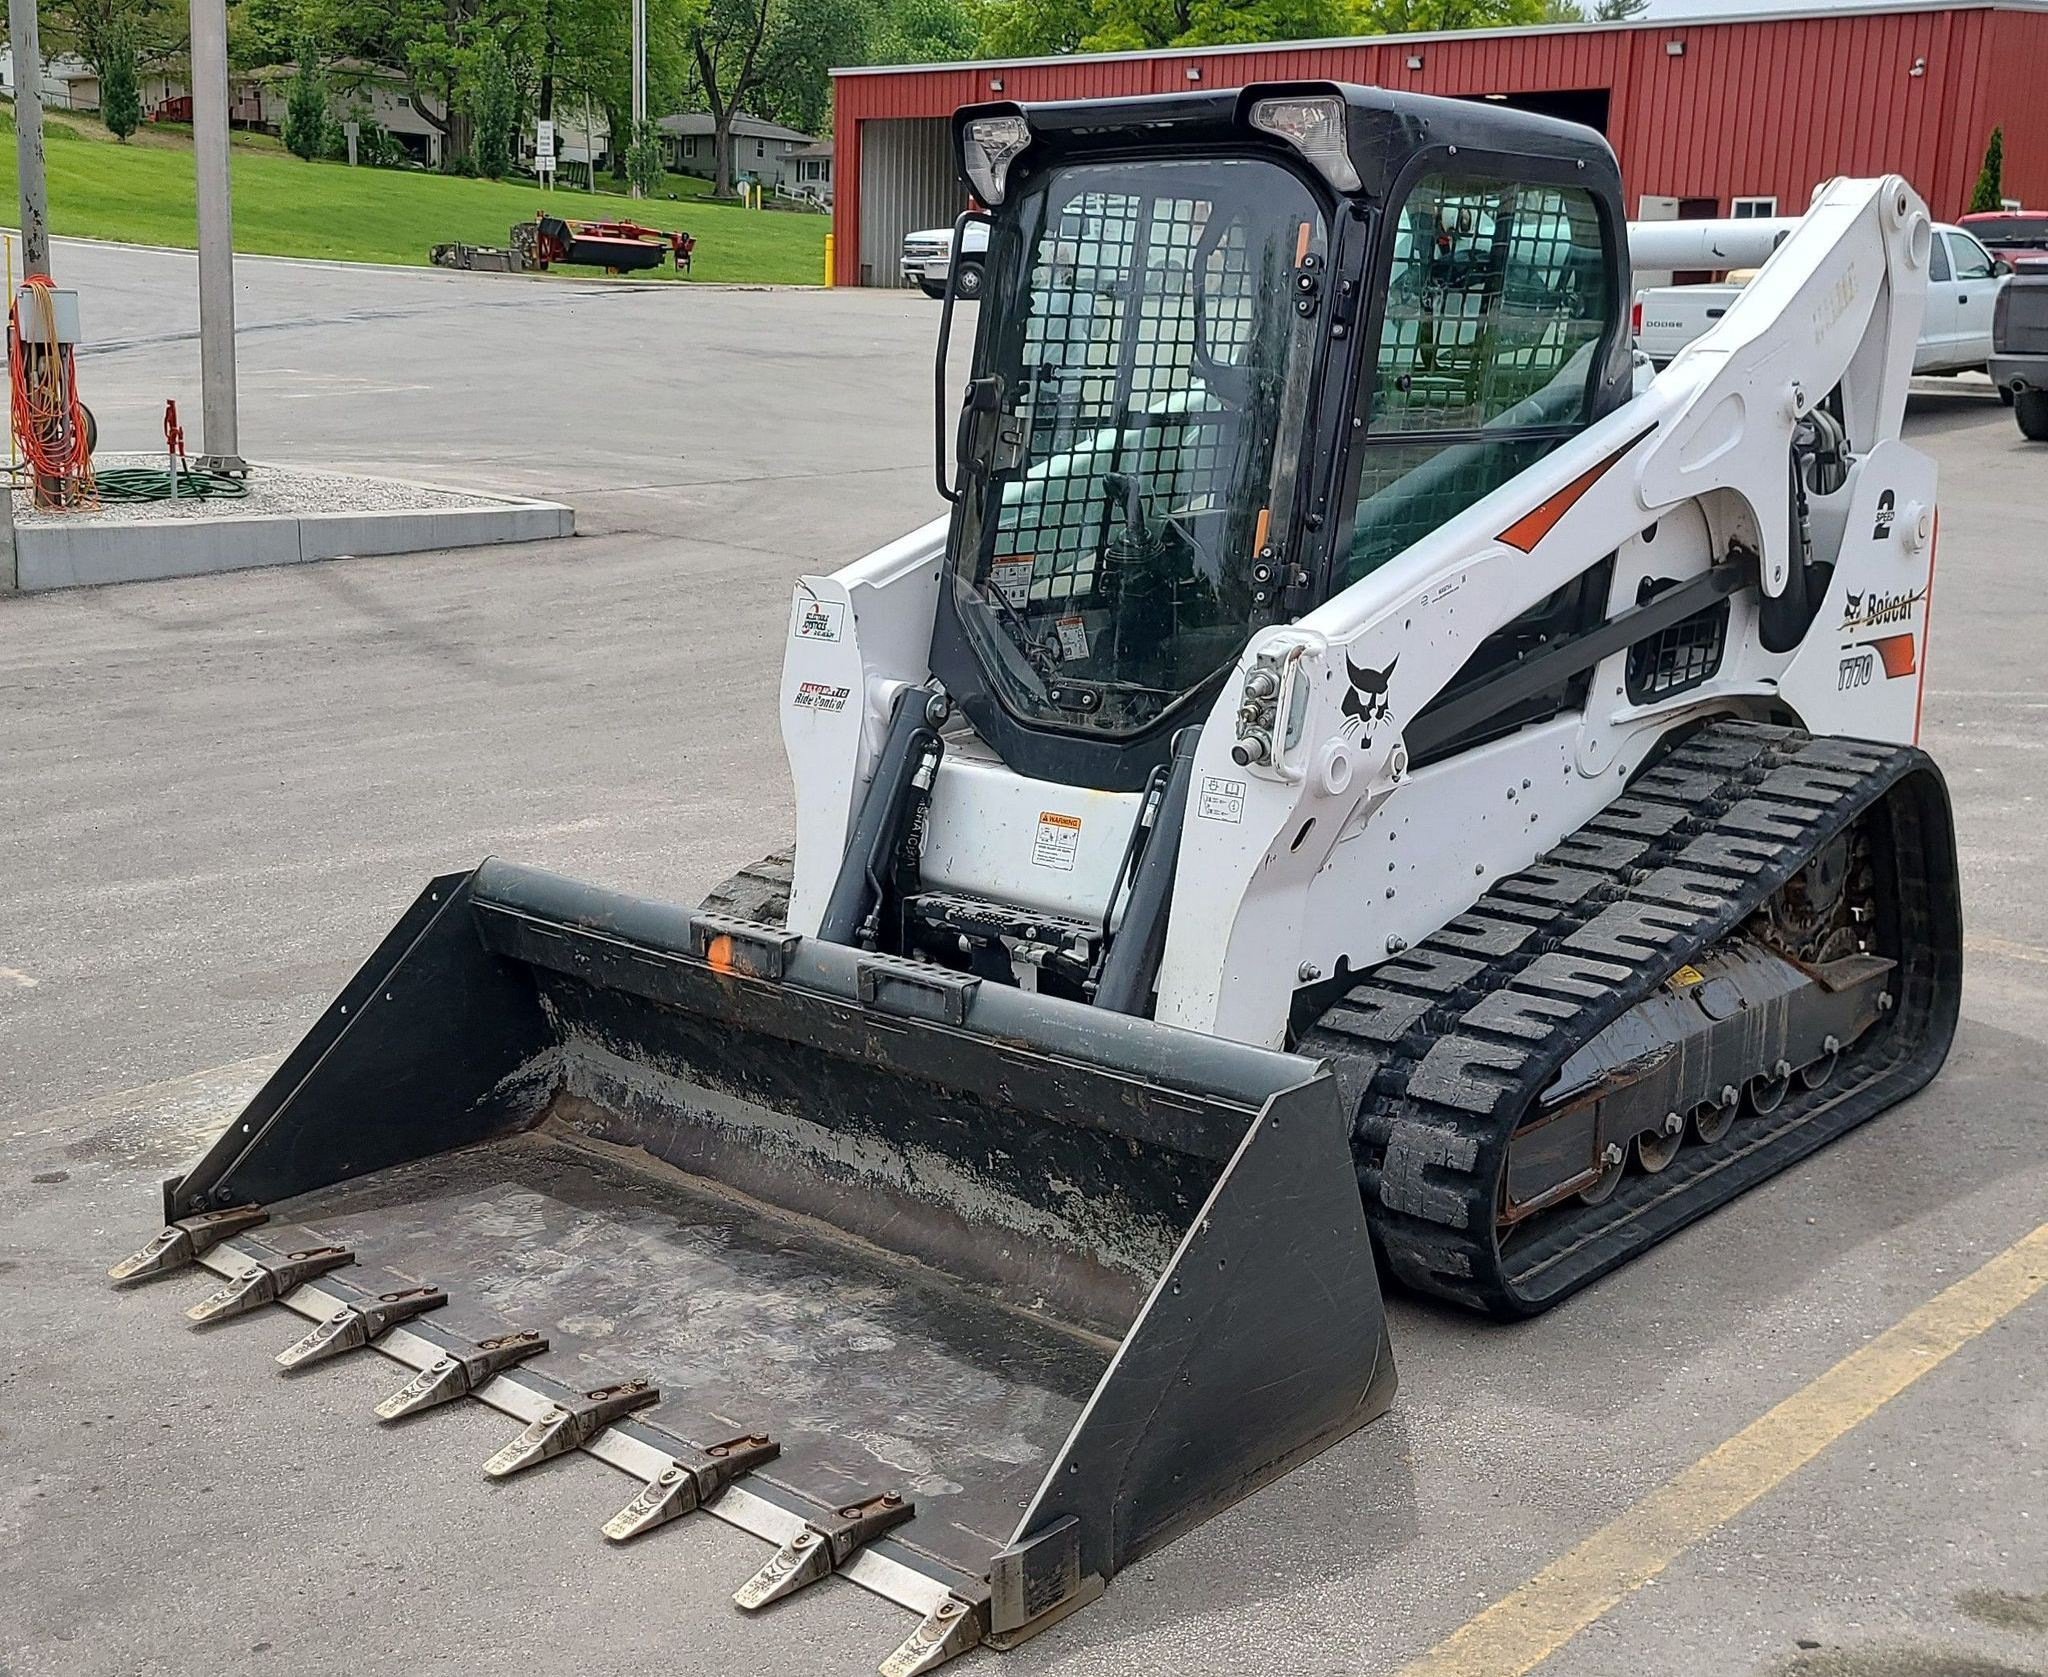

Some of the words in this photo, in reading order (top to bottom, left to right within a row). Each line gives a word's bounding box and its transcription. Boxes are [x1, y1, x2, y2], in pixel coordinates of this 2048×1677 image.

[1872, 489, 1895, 540] 2
[1875, 511, 1895, 522] SPEED
[1866, 588, 1912, 626] Bobcat
[1838, 654, 1873, 691] T770
[794, 692, 814, 705] Ride
[813, 695, 846, 710] Control
[1049, 814, 1078, 827] WARNING
